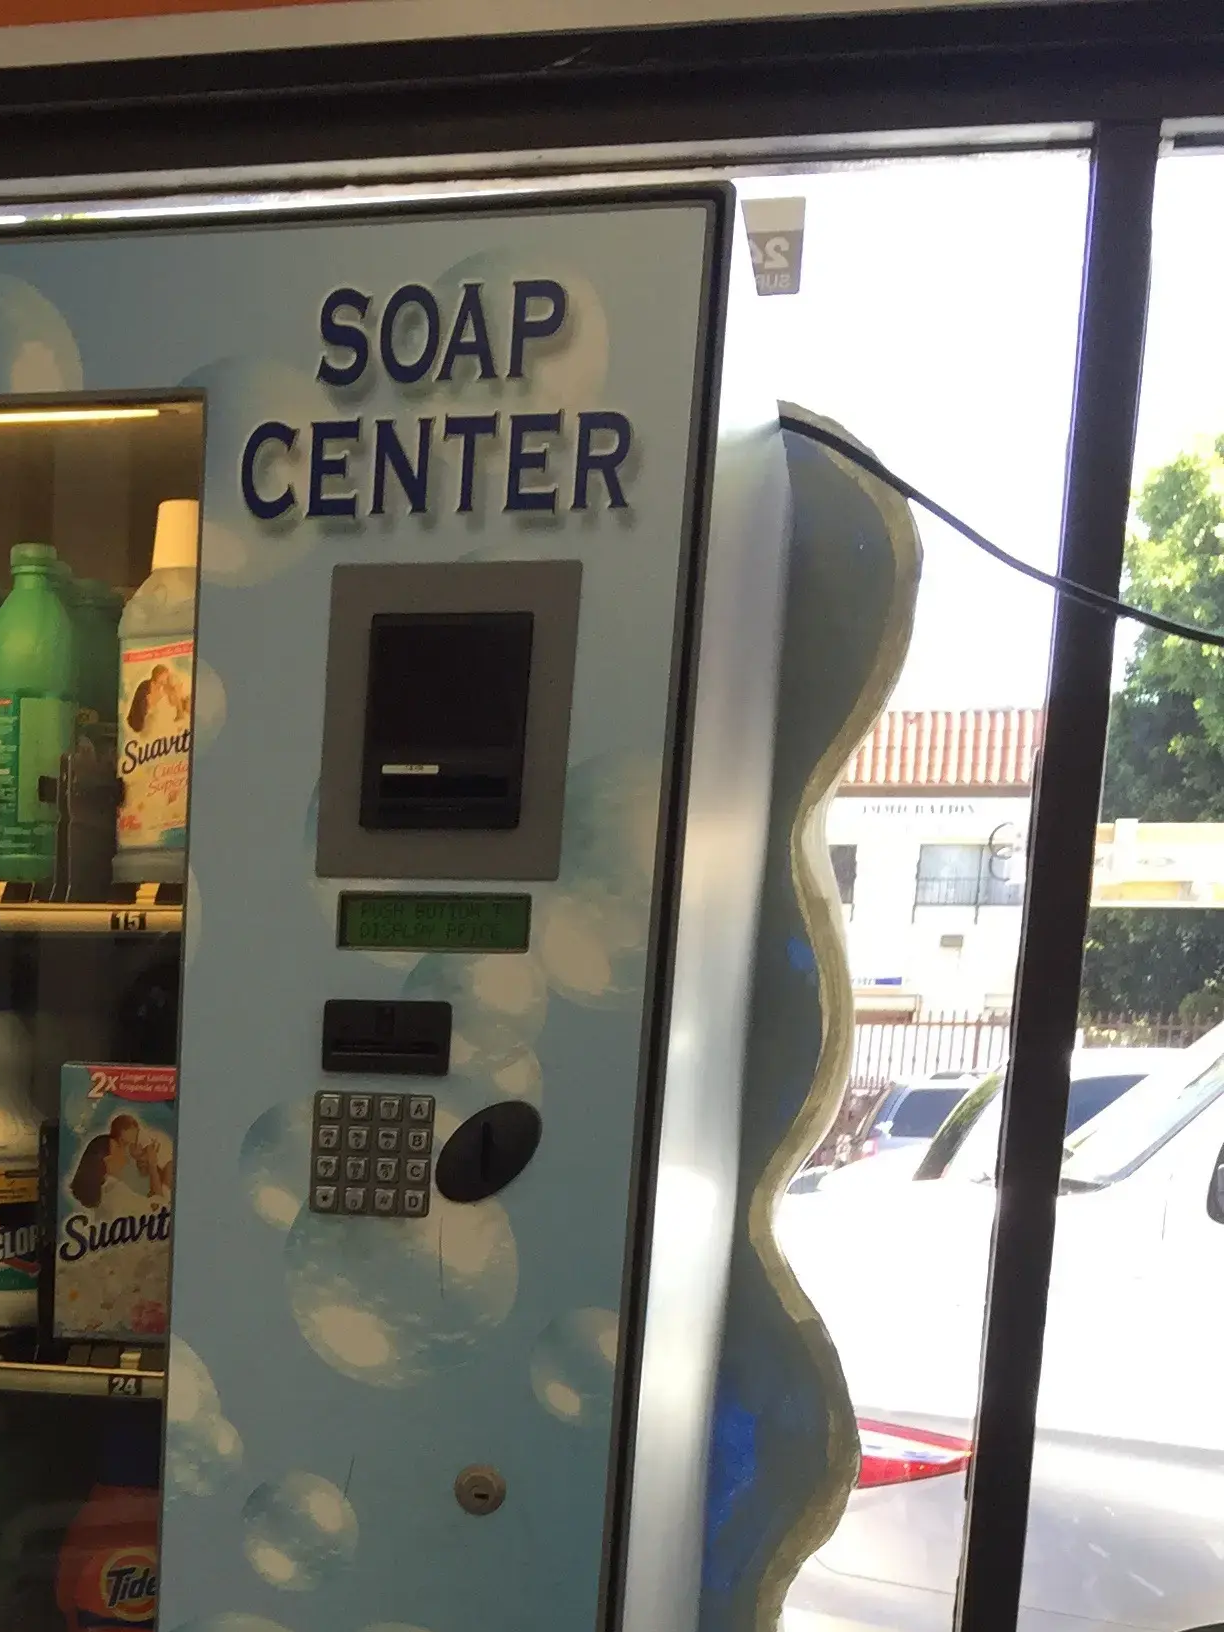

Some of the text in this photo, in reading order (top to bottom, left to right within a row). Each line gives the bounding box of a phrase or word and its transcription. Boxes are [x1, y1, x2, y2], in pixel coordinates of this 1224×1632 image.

[317, 279, 567, 387] SOAP
[241, 409, 632, 519] CENTER
[117, 911, 142, 931] 15
[413, 1103, 424, 1116] A
[412, 1135, 423, 1147] B
[410, 1165, 421, 1178] C
[408, 1196, 419, 1208] D
[111, 1376, 137, 1395] 24
[106, 1567, 156, 1607] Tide
